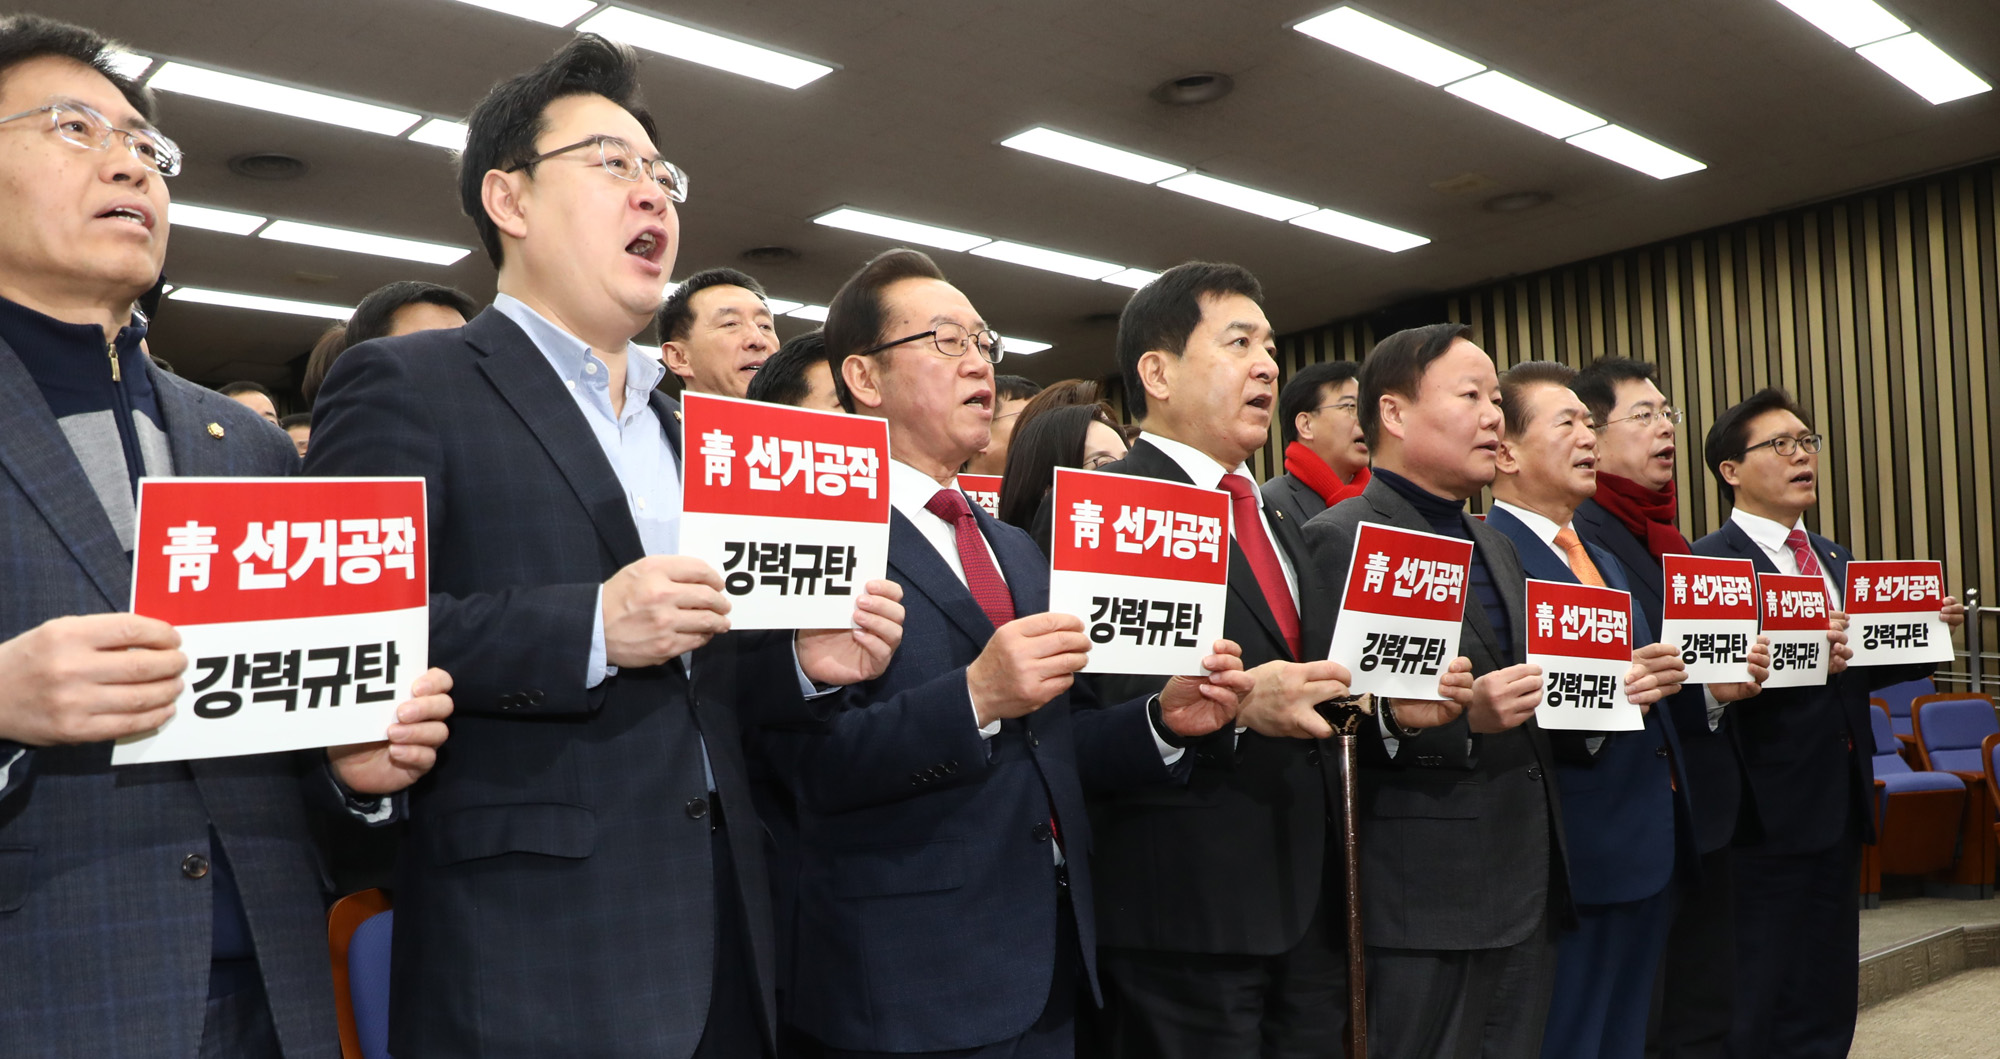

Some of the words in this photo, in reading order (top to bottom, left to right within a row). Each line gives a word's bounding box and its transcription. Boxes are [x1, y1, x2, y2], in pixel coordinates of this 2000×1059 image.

[745, 435, 879, 499] 선거공작
[232, 516, 417, 590] 선거공작
[1113, 505, 1221, 563] 선거공작
[723, 541, 857, 596] 강력규탄
[1392, 556, 1464, 604] 선거공작
[1874, 575, 1940, 602] 선거공작
[1692, 575, 1753, 606] 선거공작
[1780, 590, 1826, 619] 선거공작
[1090, 596, 1202, 647] 강력규탄
[1559, 604, 1628, 645] 선거공작
[1863, 623, 1928, 650] 강력규탄
[1360, 632, 1446, 675] 강력규탄
[1681, 633, 1747, 665] 강력규탄
[1772, 643, 1820, 670] 강력규탄
[191, 641, 400, 719] 강력규탄
[1547, 672, 1617, 709] 강력규탄
